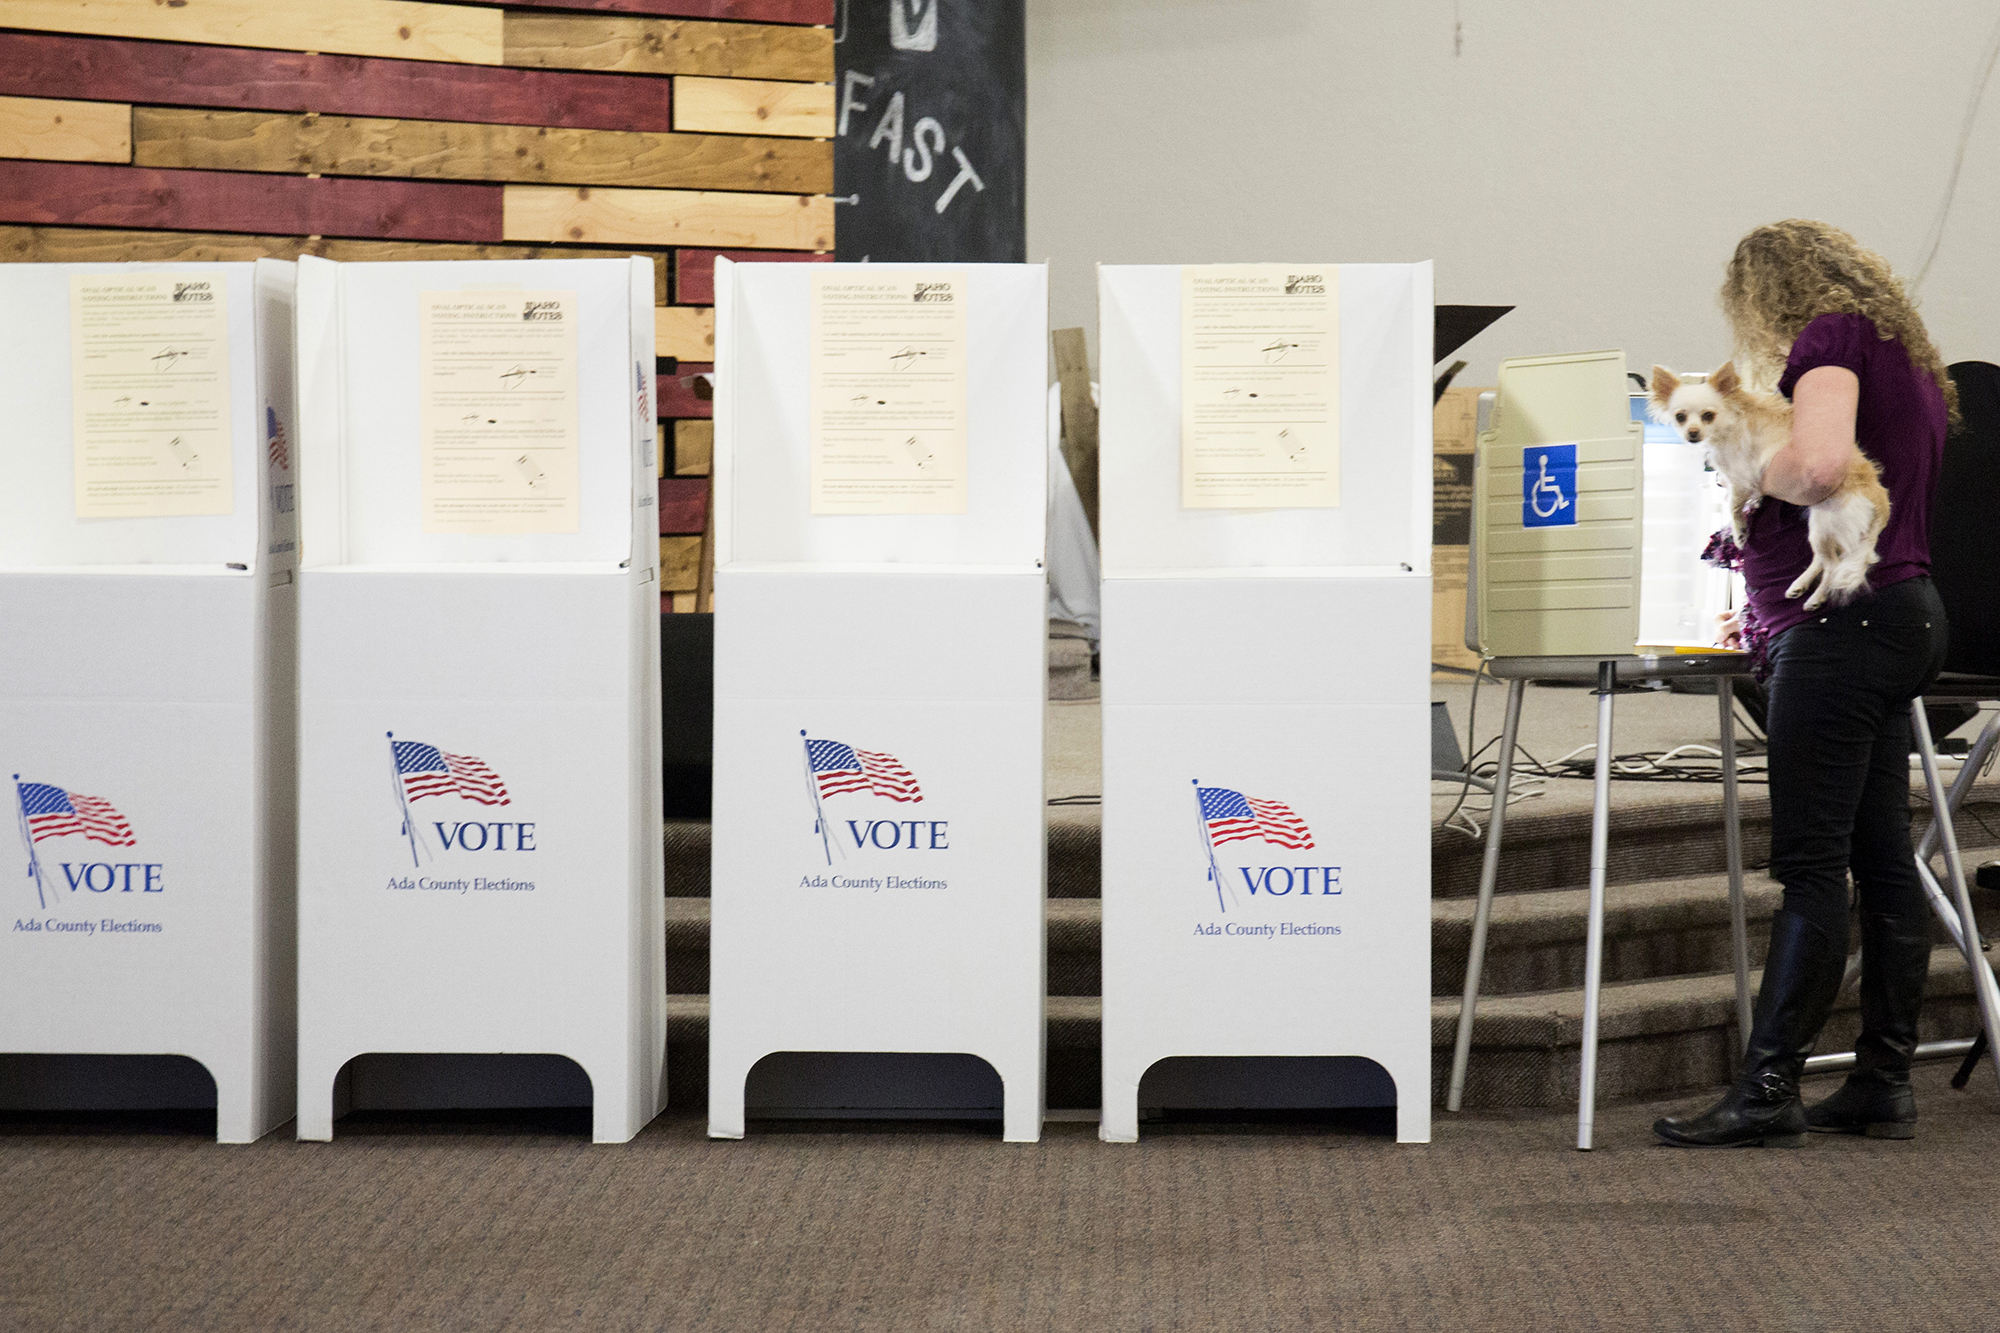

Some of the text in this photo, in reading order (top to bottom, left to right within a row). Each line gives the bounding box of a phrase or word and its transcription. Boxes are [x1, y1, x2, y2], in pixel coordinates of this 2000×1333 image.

[837, 69, 985, 214] FAST
[174, 282, 211, 291] IDAHO
[915, 282, 951, 291] IDAHO
[1286, 274, 1323, 283] IDAHO
[524, 301, 560, 310] IDAHO
[432, 822, 537, 852] VOTE
[845, 820, 950, 850] VOTE
[59, 863, 164, 893] VOTE
[386, 876, 536, 895] Ada County Elections
[799, 875, 948, 893] Ada County Elections
[1238, 866, 1343, 896] VOTE
[13, 918, 163, 936] Ada County Elections
[1193, 922, 1342, 940] Ada County Elections
